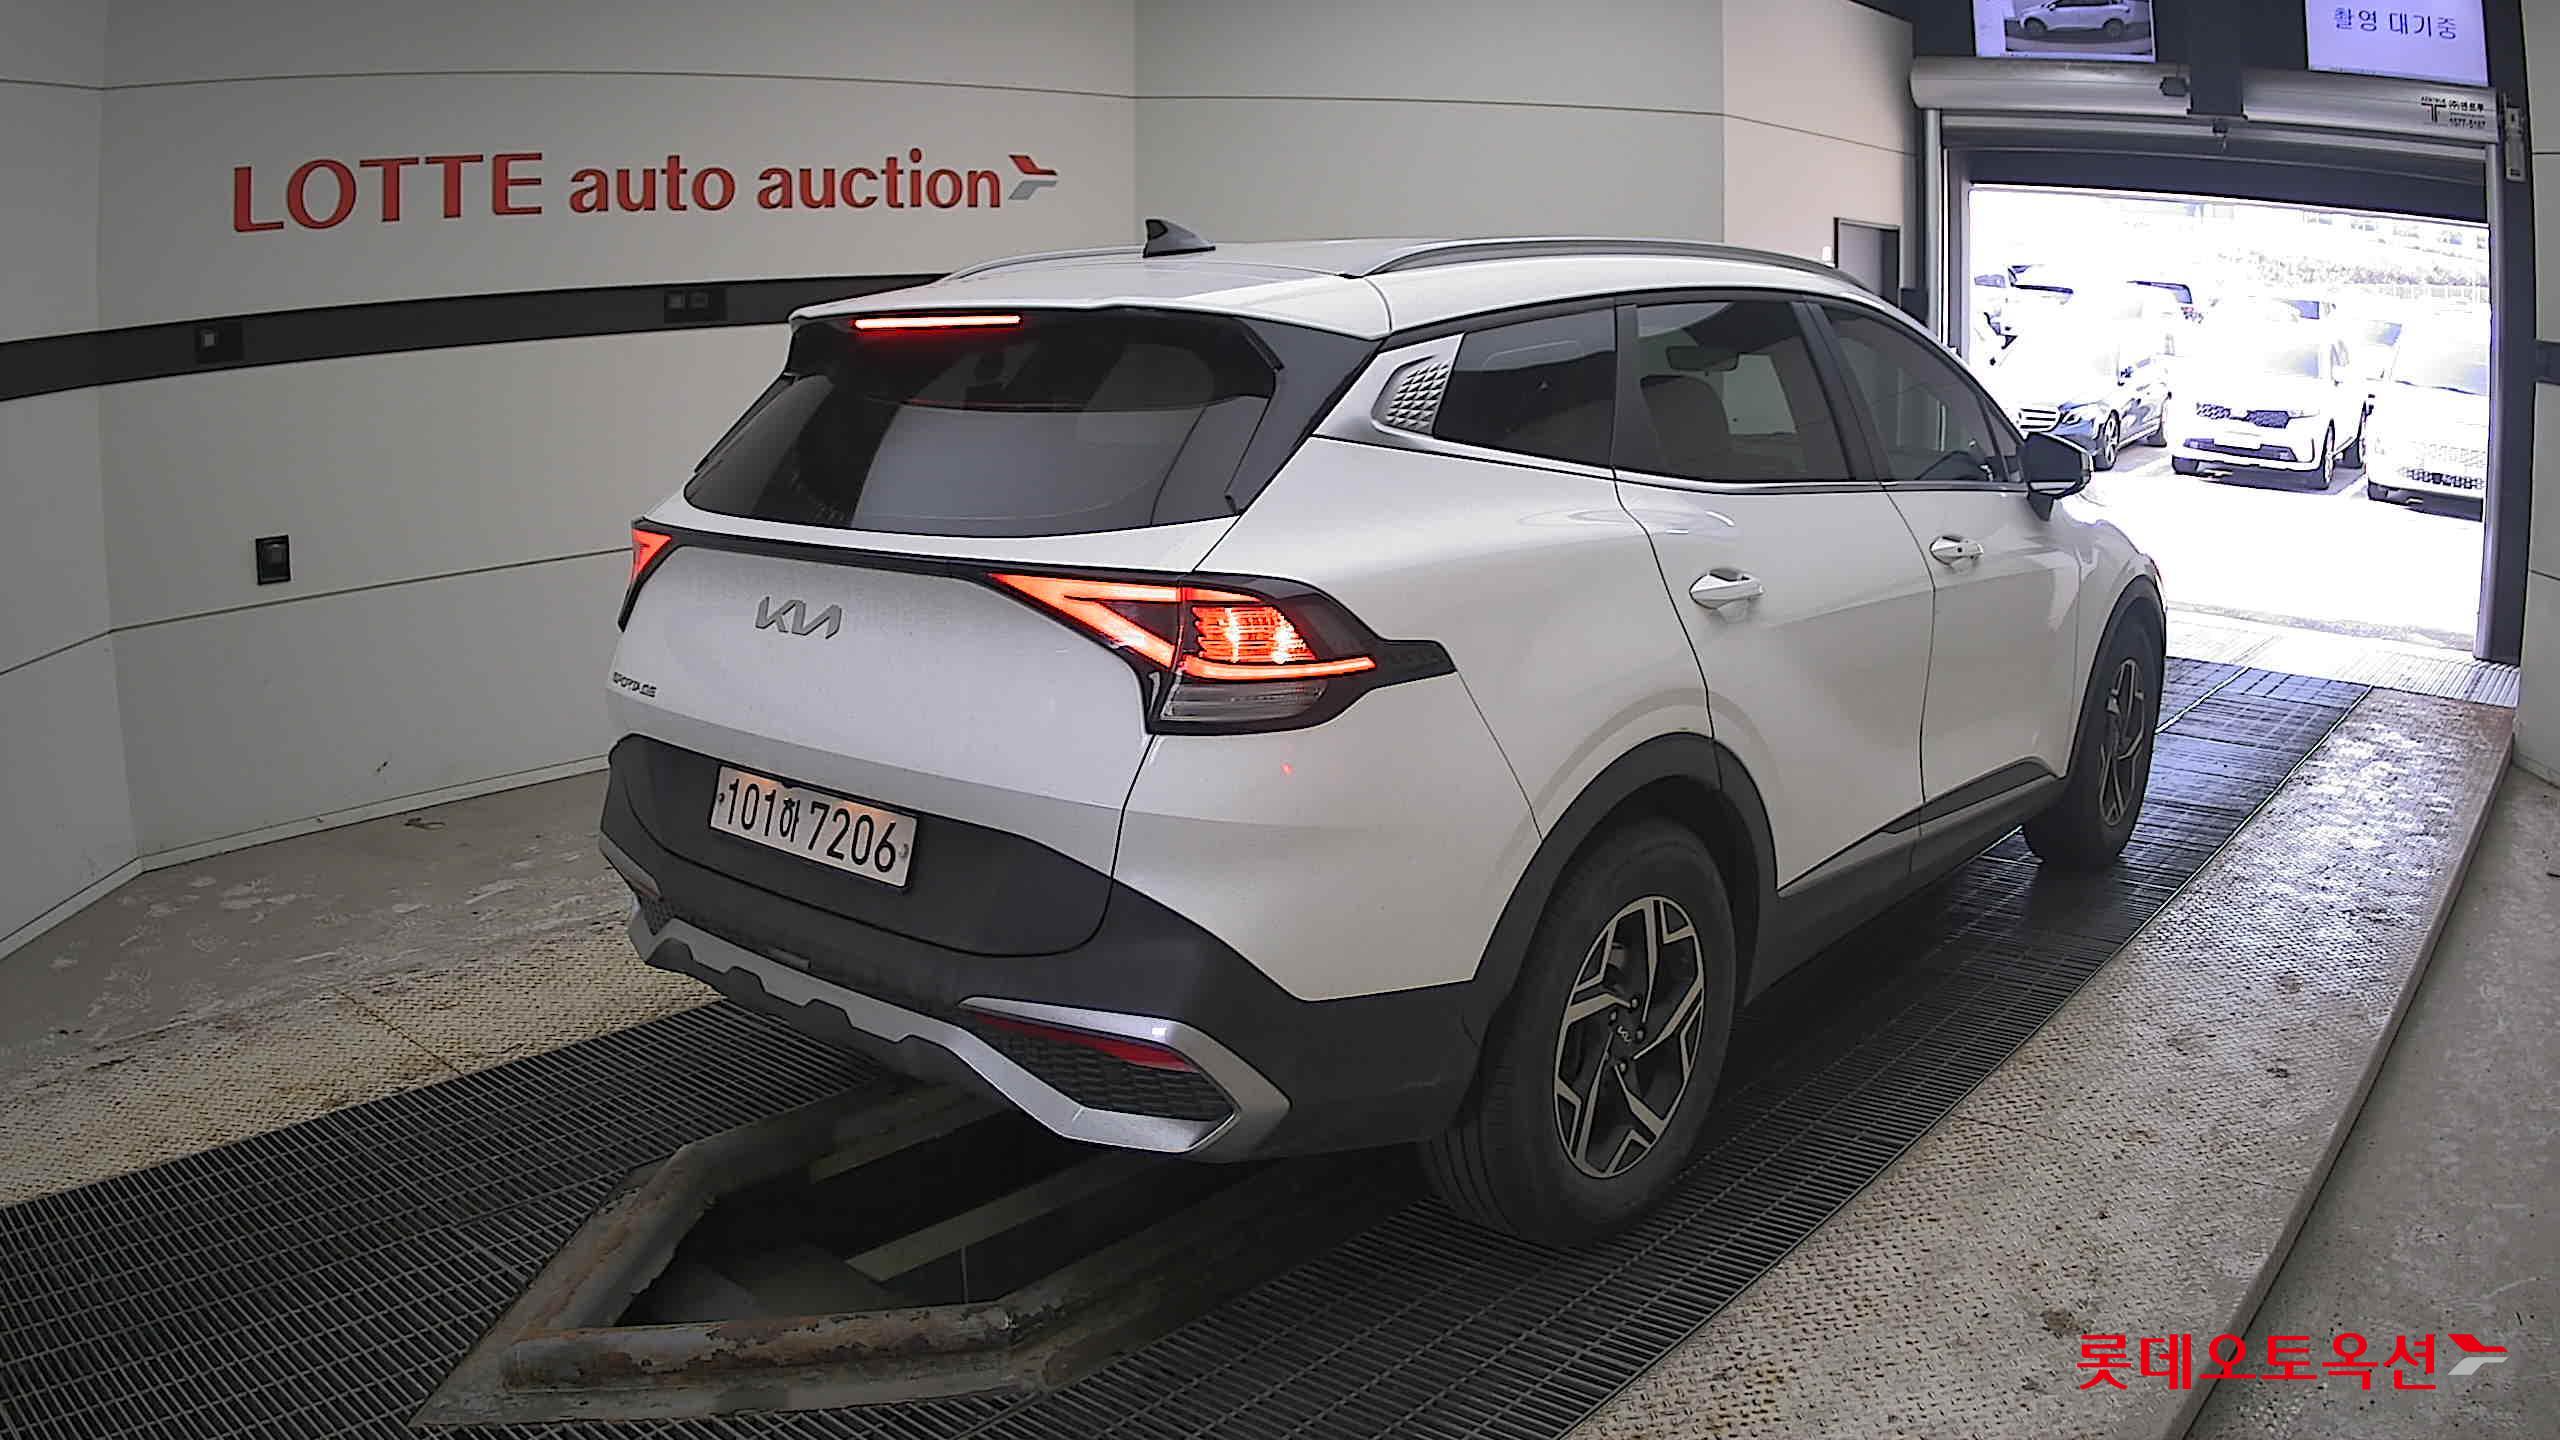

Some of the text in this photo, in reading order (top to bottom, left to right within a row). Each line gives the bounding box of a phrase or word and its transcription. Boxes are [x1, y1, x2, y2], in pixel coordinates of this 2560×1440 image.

[2389, 12, 2456, 40] 대기중
[234, 148, 1001, 232] LOTTE auto auction
[755, 596, 842, 639] KIA
